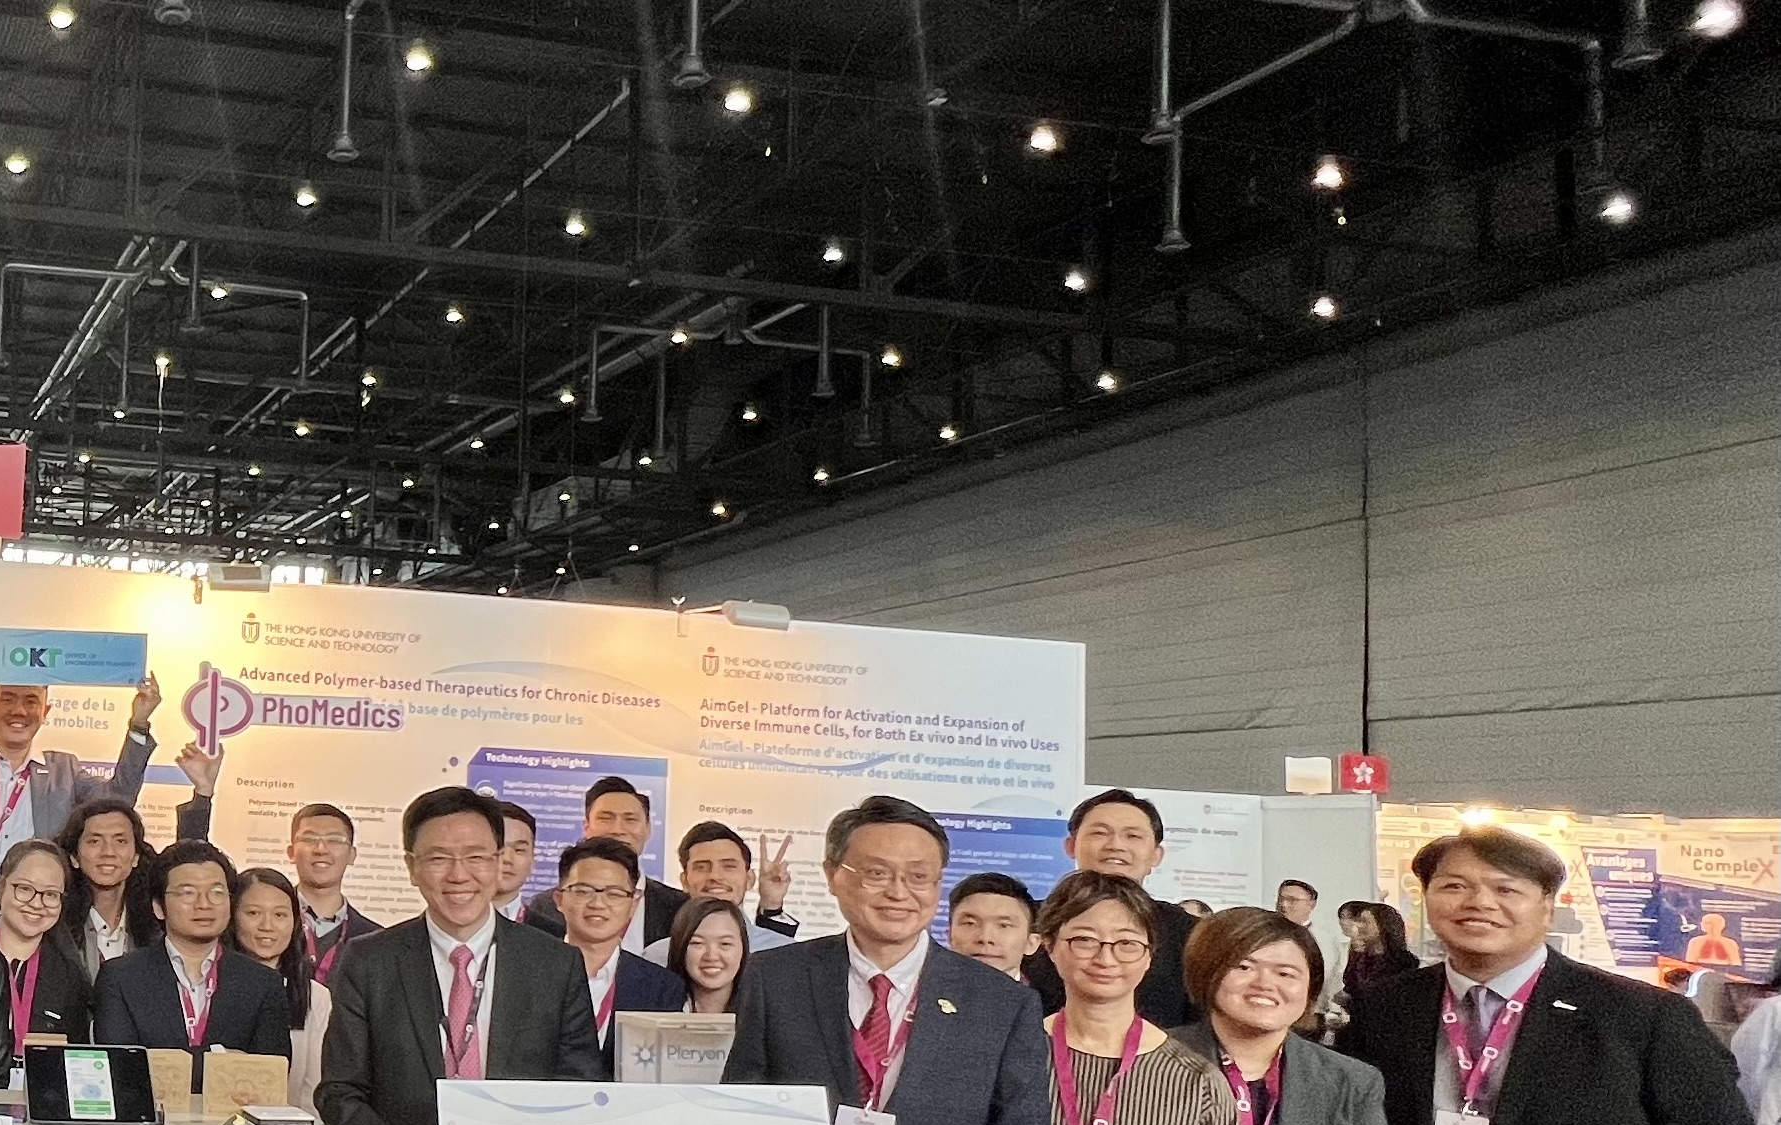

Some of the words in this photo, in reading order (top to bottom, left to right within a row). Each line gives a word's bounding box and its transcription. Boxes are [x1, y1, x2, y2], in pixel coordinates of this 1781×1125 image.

[265, 624, 282, 632] THE
[286, 626, 317, 635] HONG
[320, 629, 350, 637] KONG
[353, 631, 405, 641] UNIVERSITY
[265, 637, 304, 646] SCIENCE
[333, 642, 399, 652] TECHNOLOGY
[10, 646, 63, 668] OKT
[724, 657, 739, 665] THE
[743, 659, 771, 667] HONG
[774, 662, 802, 670] KONG
[805, 664, 853, 673] UNIVERSITY
[724, 670, 761, 679] SCIENCE
[786, 674, 848, 684] TECHNOLOGY
[240, 667, 309, 686] Advanced
[315, 673, 421, 691] Polymer-based
[427, 680, 517, 698] Therapeutics
[522, 686, 541, 699] for
[546, 688, 597, 703] Chronic
[603, 692, 660, 708] Diseases
[261, 696, 402, 729] PhoMedics
[408, 702, 438, 715] base
[441, 704, 458, 717] de
[461, 706, 530, 721] polymères
[532, 714, 562, 724] pour
[565, 713, 583, 725] les
[700, 698, 748, 714] AimGel
[760, 702, 819, 718] Platform
[824, 706, 840, 719] for
[844, 708, 912, 724] Activation
[915, 714, 940, 726] and
[943, 716, 1008, 732] Expansion
[1012, 720, 1026, 732] of
[54, 716, 110, 730] mobiles
[700, 715, 750, 730] Diverse
[754, 720, 810, 735] Immune
[814, 724, 849, 740] Cells,
[852, 726, 870, 738] for
[875, 728, 906, 741] Both
[910, 730, 924, 742] Ex
[928, 730, 954, 744] vivo
[958, 733, 982, 746] and
[986, 735, 998, 748] In
[1000, 736, 1028, 750] vivo
[1030, 738, 1060, 752] Uses
[485, 753, 540, 766] Technology
[542, 756, 590, 769] Highlights
[754, 742, 819, 757] Plateforme
[912, 753, 984, 768] d'expansion
[1004, 757, 1051, 772] diverses
[236, 777, 295, 790] Description
[699, 804, 753, 816] Description
[967, 819, 1012, 831] Highlights
[1680, 844, 1724, 858] Nano
